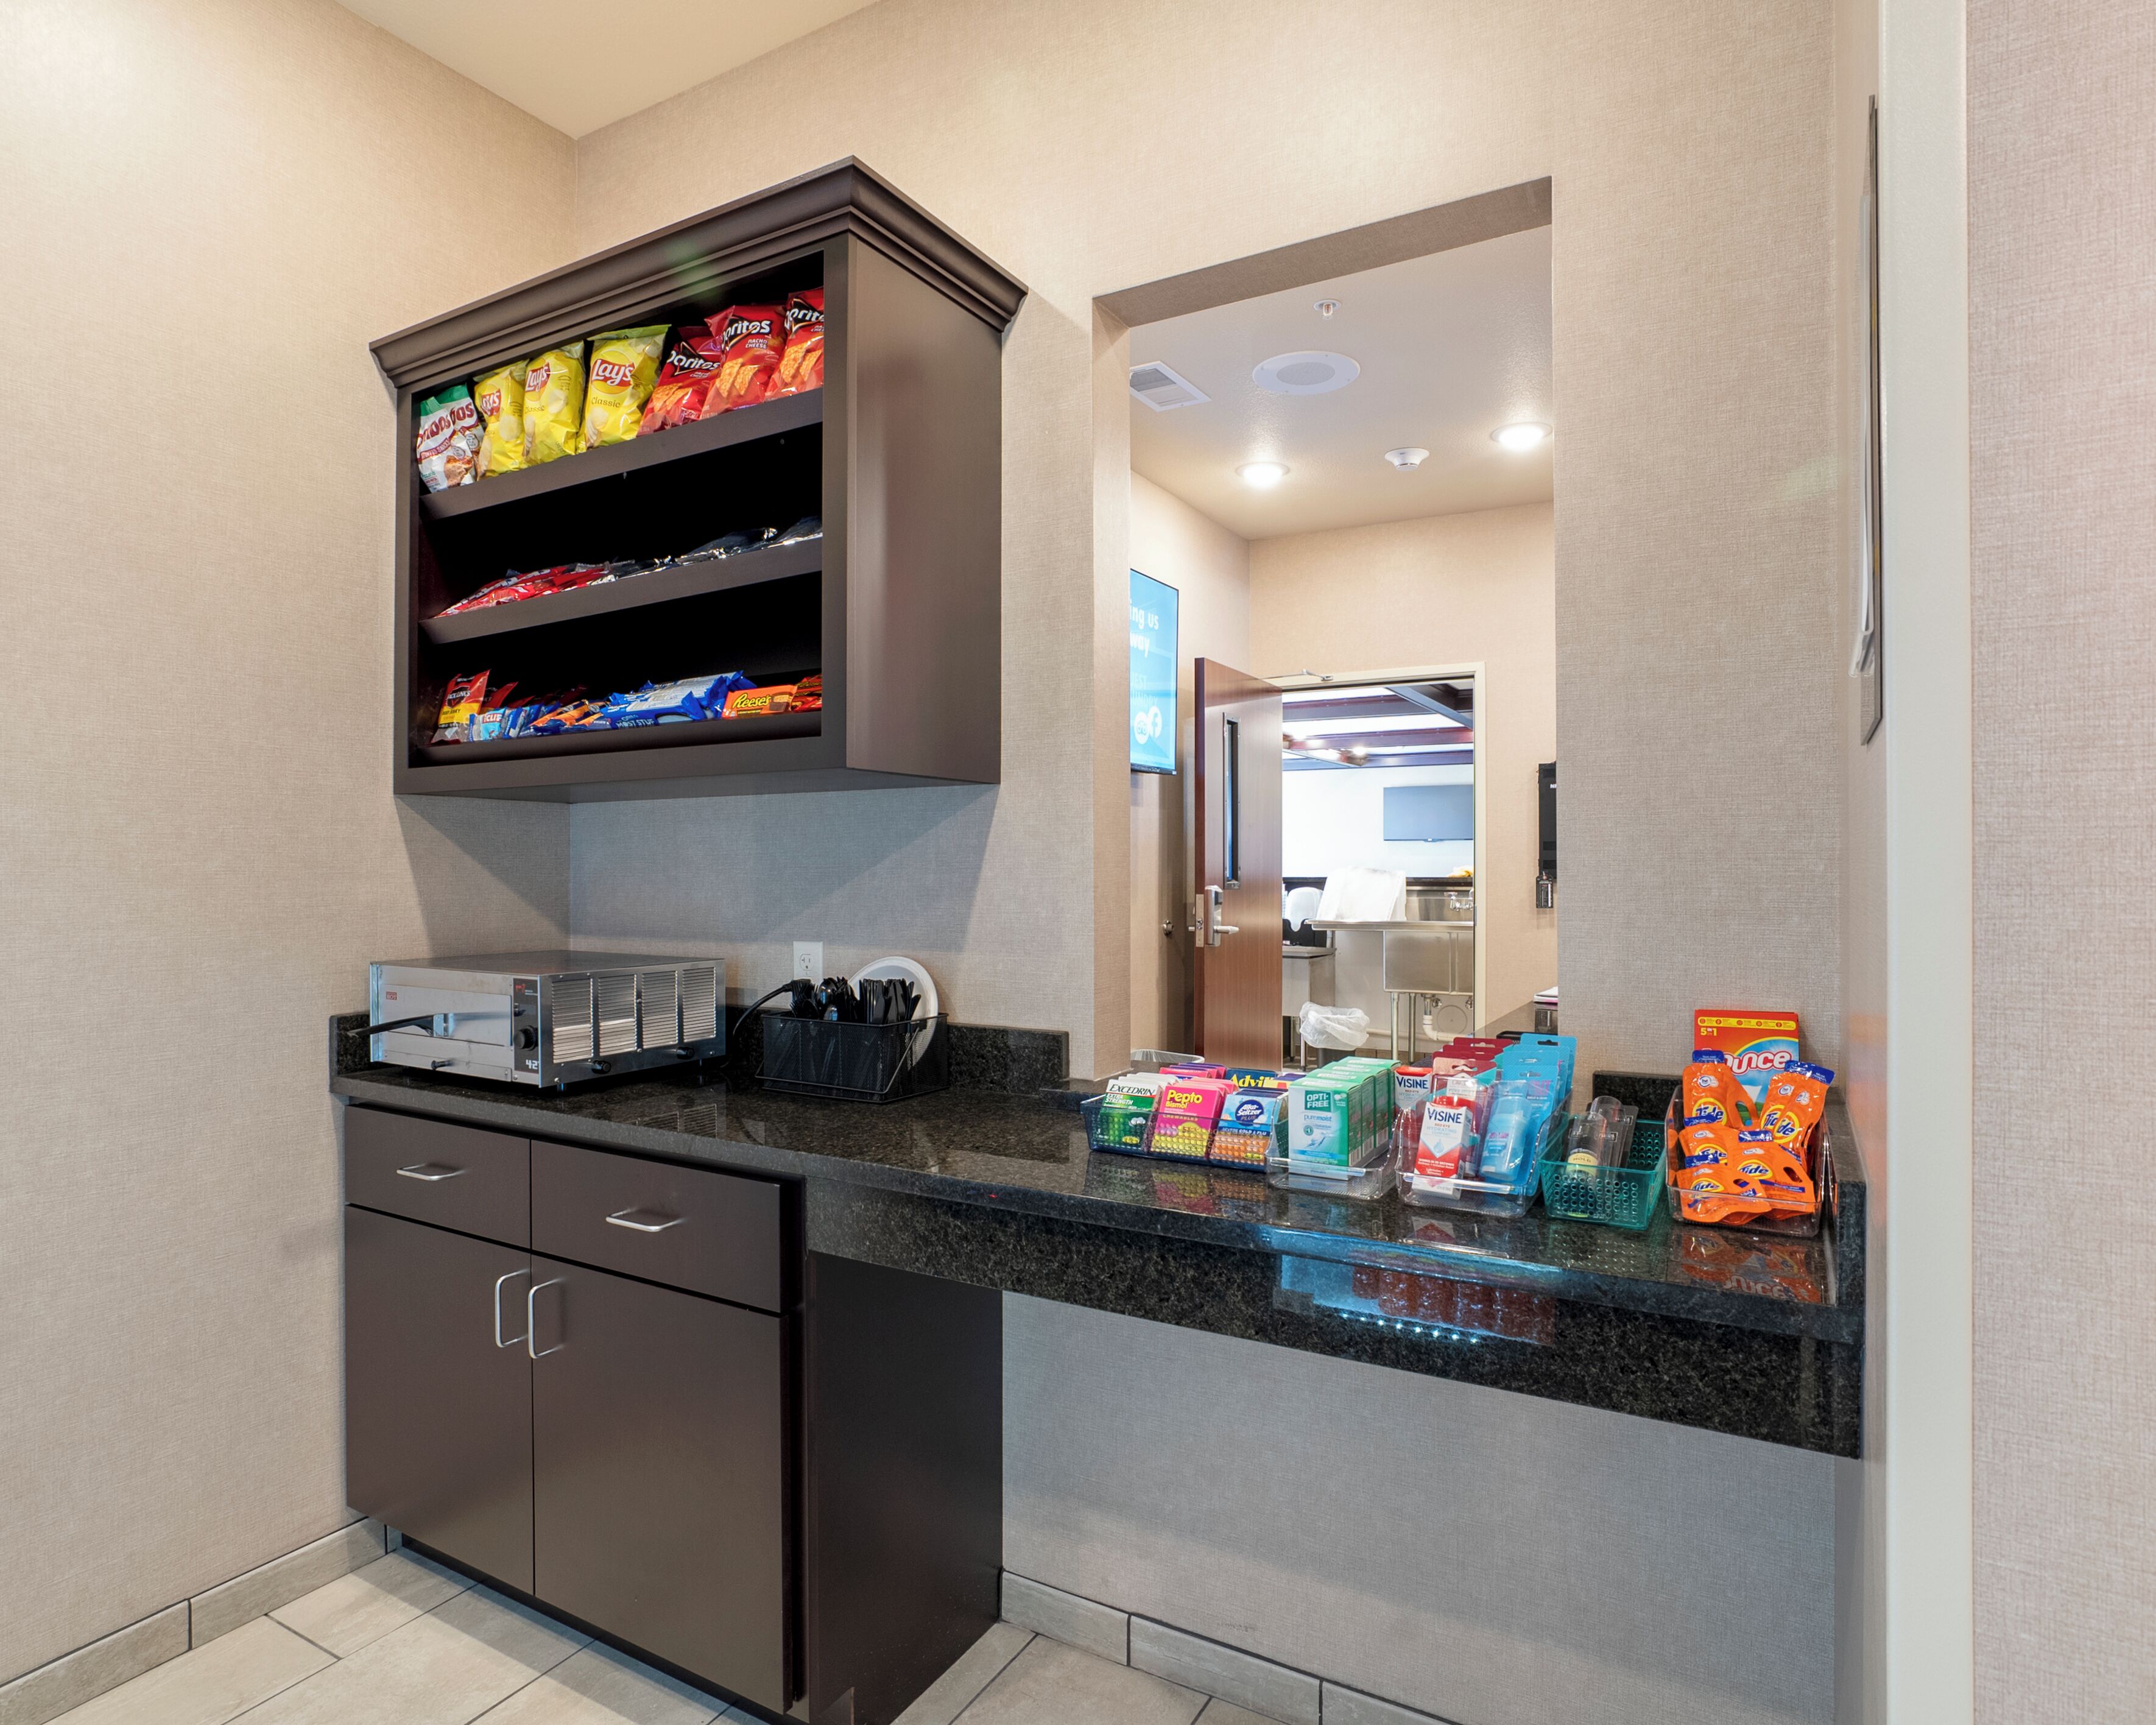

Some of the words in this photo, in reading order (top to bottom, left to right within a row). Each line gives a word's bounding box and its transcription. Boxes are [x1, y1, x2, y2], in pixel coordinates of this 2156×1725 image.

[525, 366, 548, 392] Lay's
[592, 359, 633, 386] Lay's
[591, 397, 621, 407] Classic
[1147, 612, 1159, 630] us
[732, 693, 772, 708] Reese's
[616, 720, 636, 728] MOST
[1723, 1051, 1791, 1075] ounce
[1231, 1074, 1270, 1087] Advi
[1396, 1076, 1429, 1089] VISINE
[1109, 1084, 1155, 1096] EXCEDRIN
[1167, 1089, 1202, 1104] Pepto
[1306, 1100, 1329, 1109] FREE
[1427, 1107, 1462, 1124] VISINE
